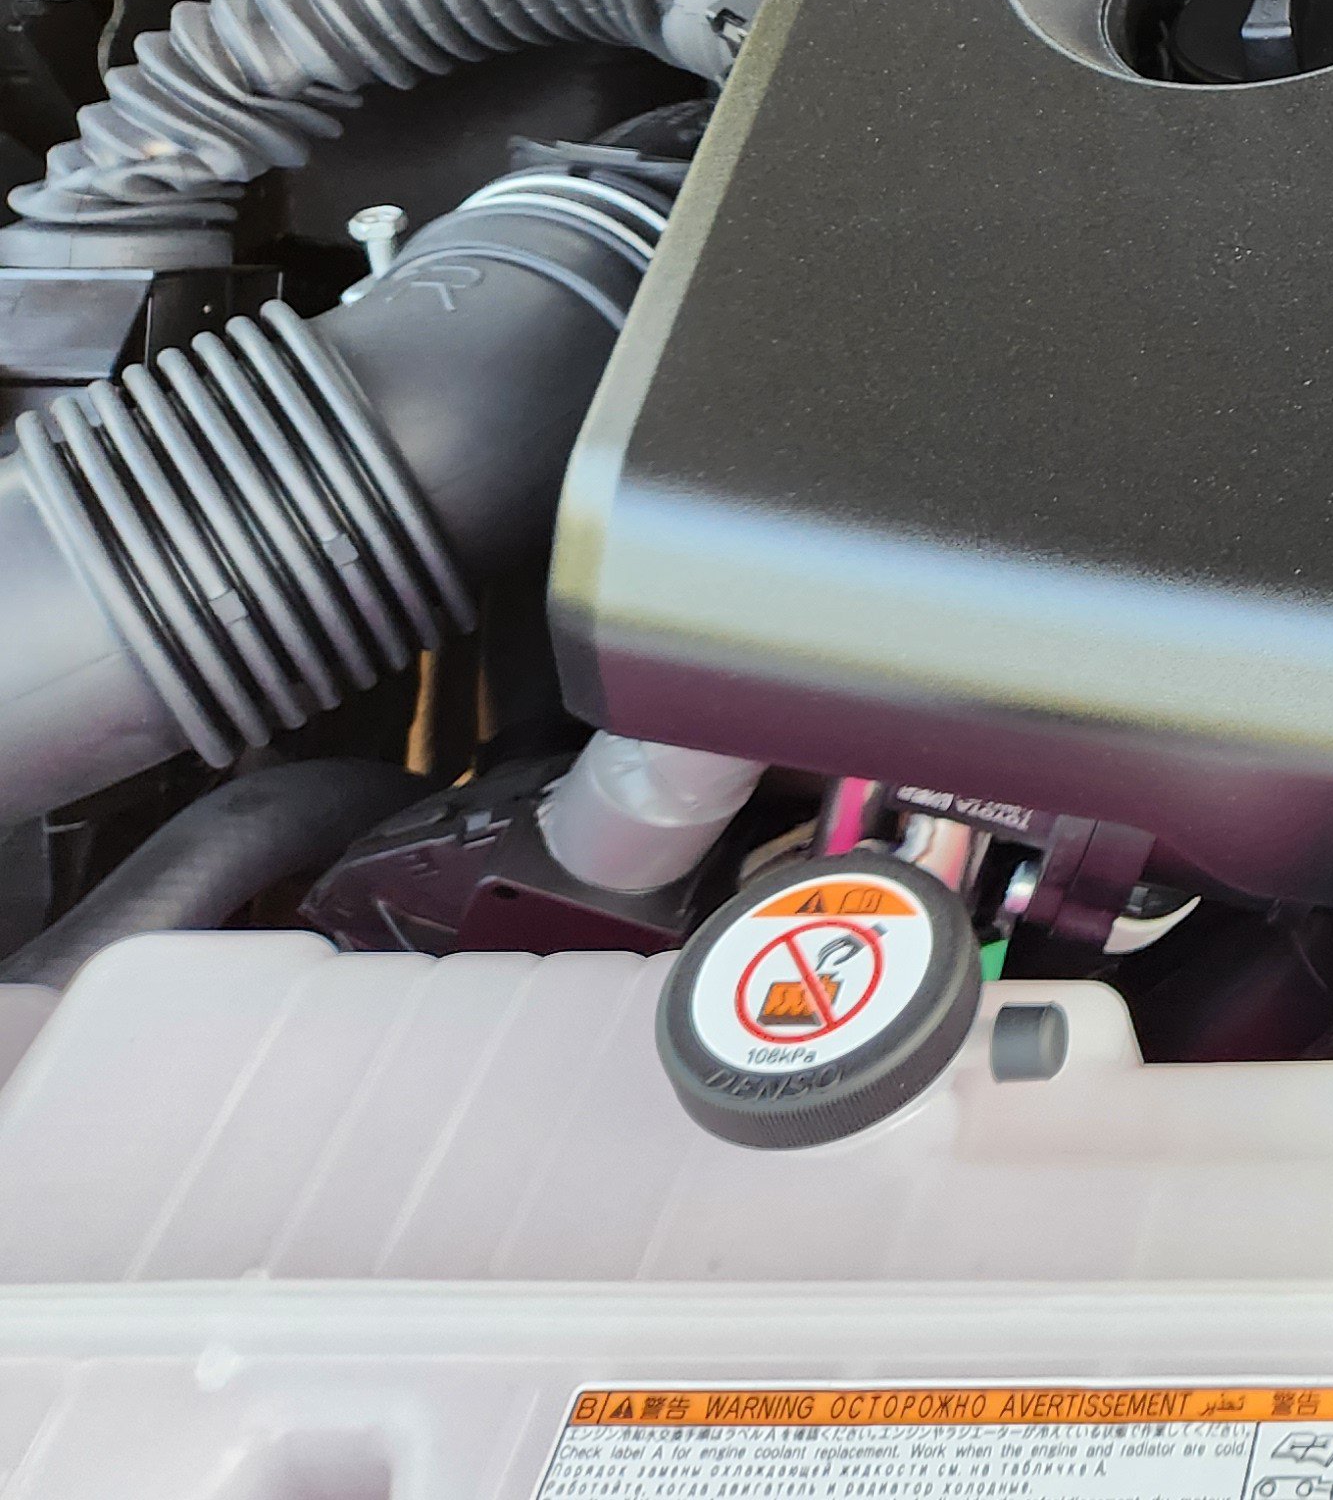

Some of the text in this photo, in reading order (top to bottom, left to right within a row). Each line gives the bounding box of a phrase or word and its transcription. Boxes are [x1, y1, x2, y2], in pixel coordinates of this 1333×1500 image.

[747, 1047, 818, 1065] 108kPa
[705, 1063, 845, 1102] DENSO
[639, 1395, 691, 1420] 警告
[704, 1396, 816, 1420] WARNING
[830, 1394, 988, 1419] ОСТОРОЖНО
[999, 1392, 1194, 1418] AVERTISSEMENT
[1270, 1390, 1321, 1416] 警告
[560, 1441, 1248, 1462] Check label A for engine coolant replacement. Work when the engine and radiator are cold.
